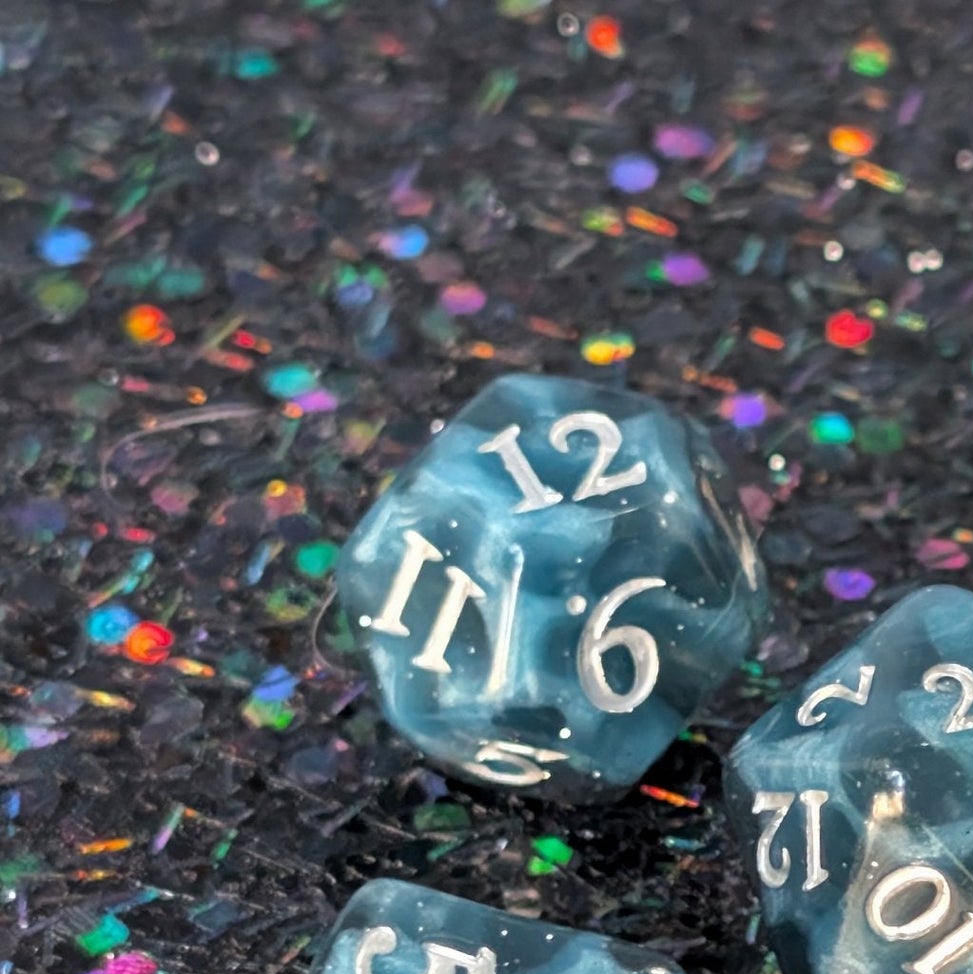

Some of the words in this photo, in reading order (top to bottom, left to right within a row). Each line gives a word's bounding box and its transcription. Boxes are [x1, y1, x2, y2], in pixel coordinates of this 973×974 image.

[477, 410, 647, 514] 12
[370, 529, 486, 673] 11
[796, 664, 877, 726] 2
[752, 789, 829, 892] 12
